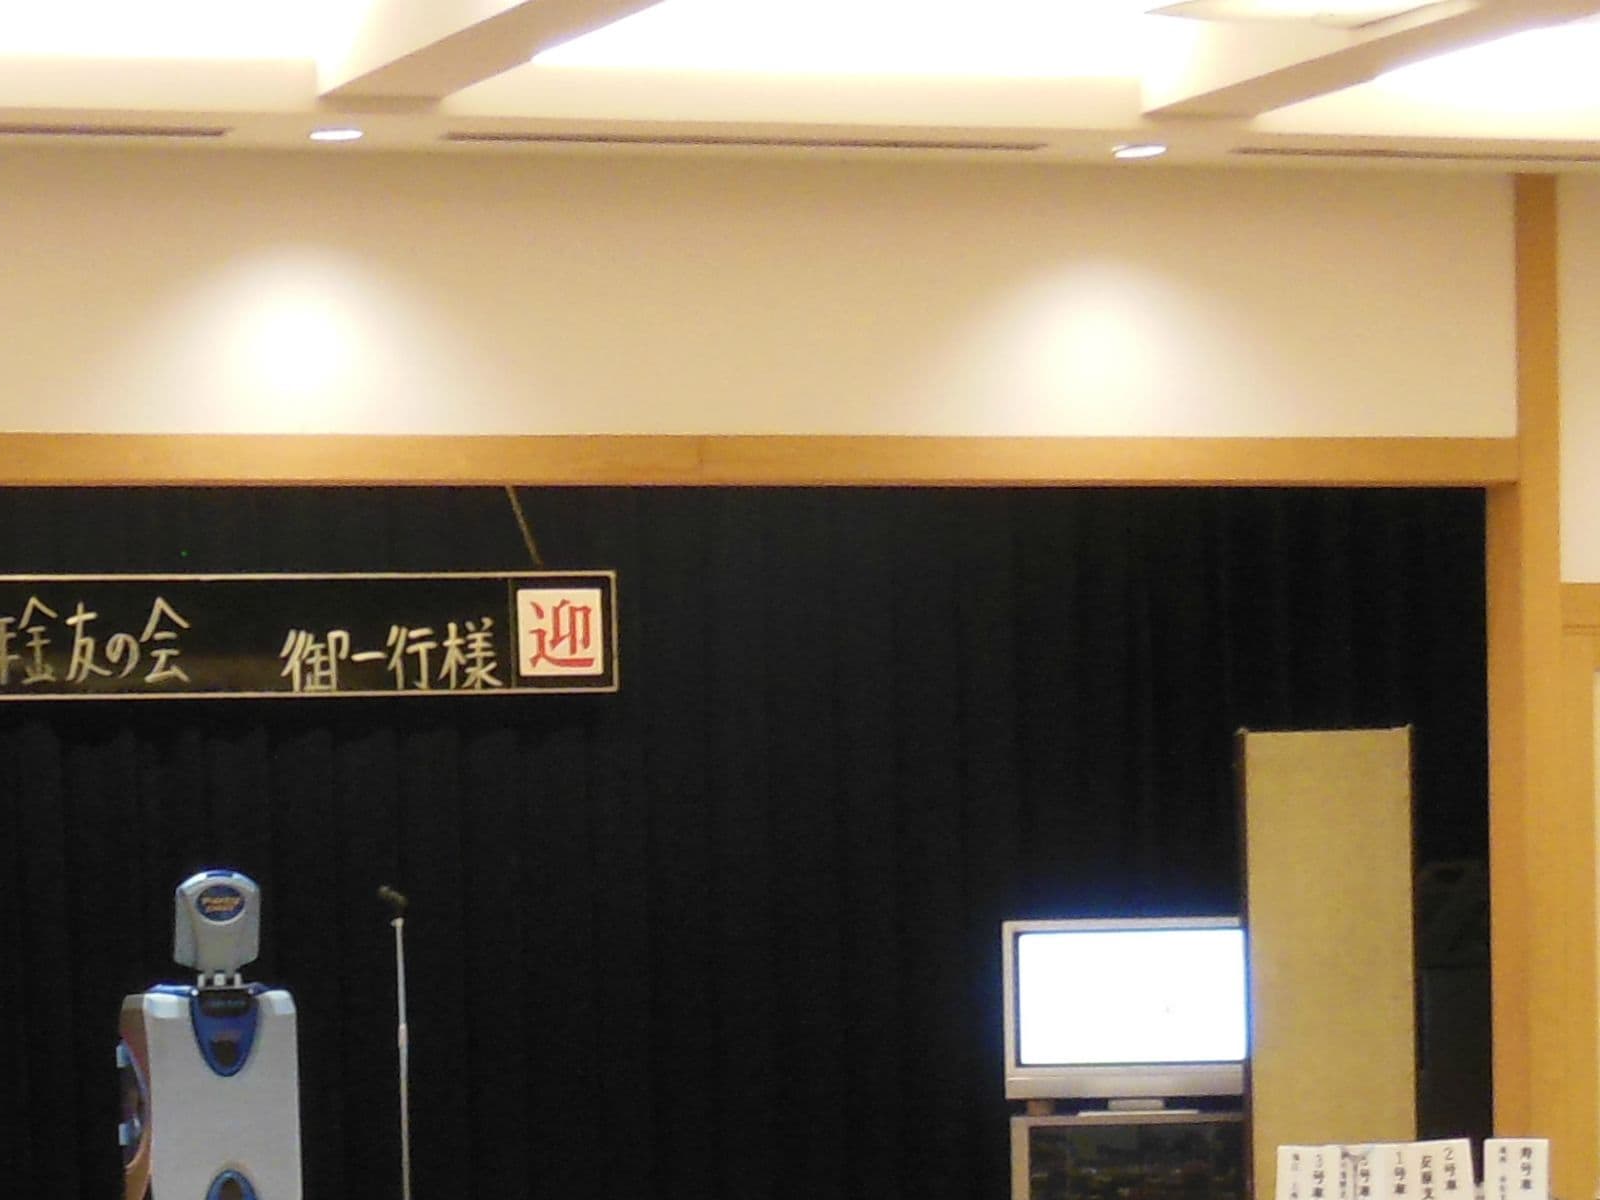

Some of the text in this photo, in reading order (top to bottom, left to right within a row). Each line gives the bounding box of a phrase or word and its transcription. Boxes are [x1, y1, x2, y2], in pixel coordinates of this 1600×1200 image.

[279, 616, 503, 692] 御一行様
[528, 600, 597, 668] 迎
